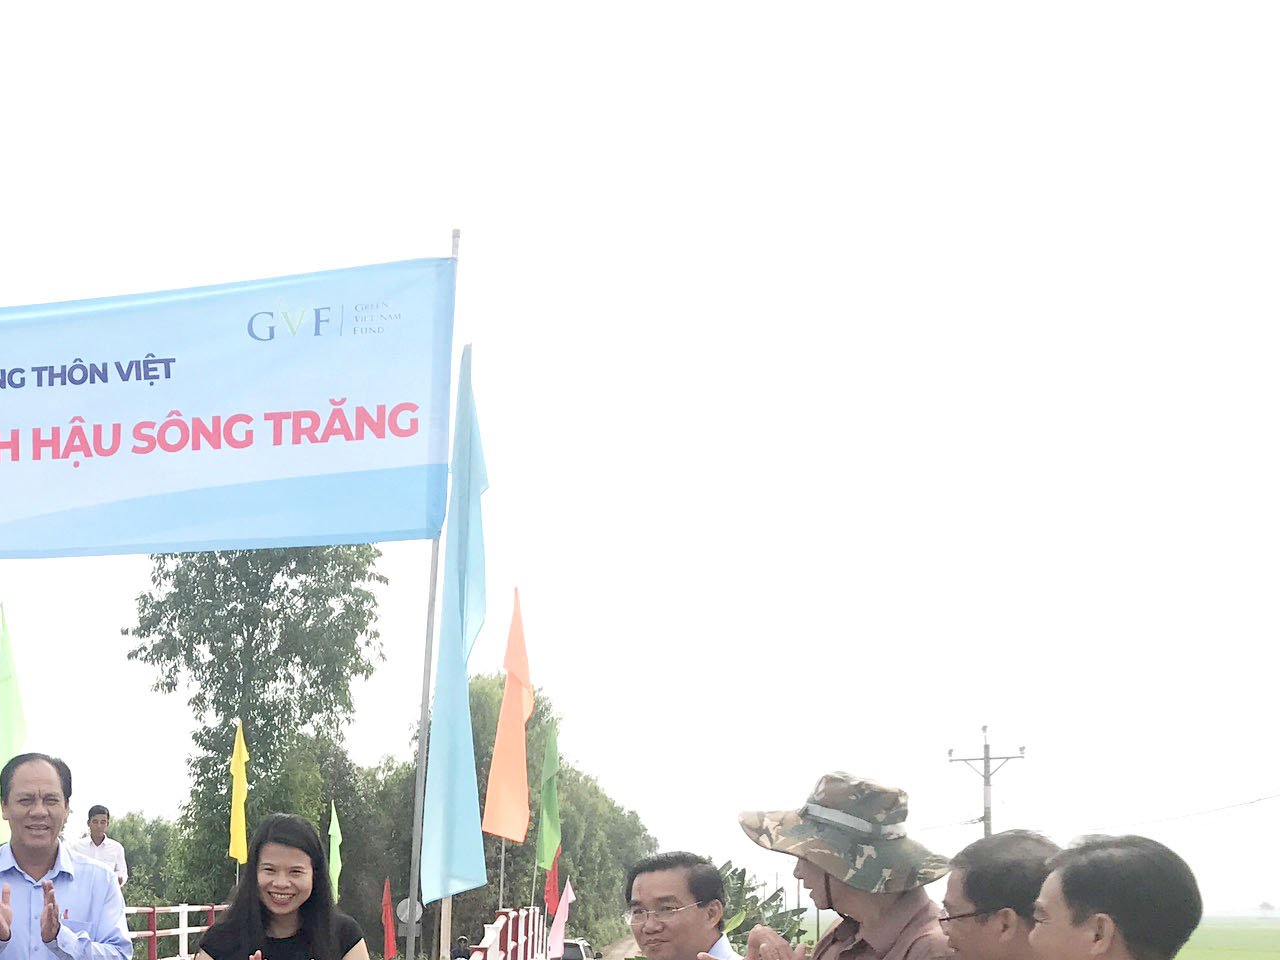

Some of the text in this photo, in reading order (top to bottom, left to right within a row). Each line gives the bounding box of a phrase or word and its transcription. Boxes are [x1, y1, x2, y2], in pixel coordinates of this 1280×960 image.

[247, 307, 330, 341] GVF
[31, 357, 108, 388] THÔN
[115, 352, 176, 386] VIỆT
[32, 415, 121, 469] HẬU
[132, 409, 253, 455] SÔNG
[264, 397, 419, 447] TRĂNG
